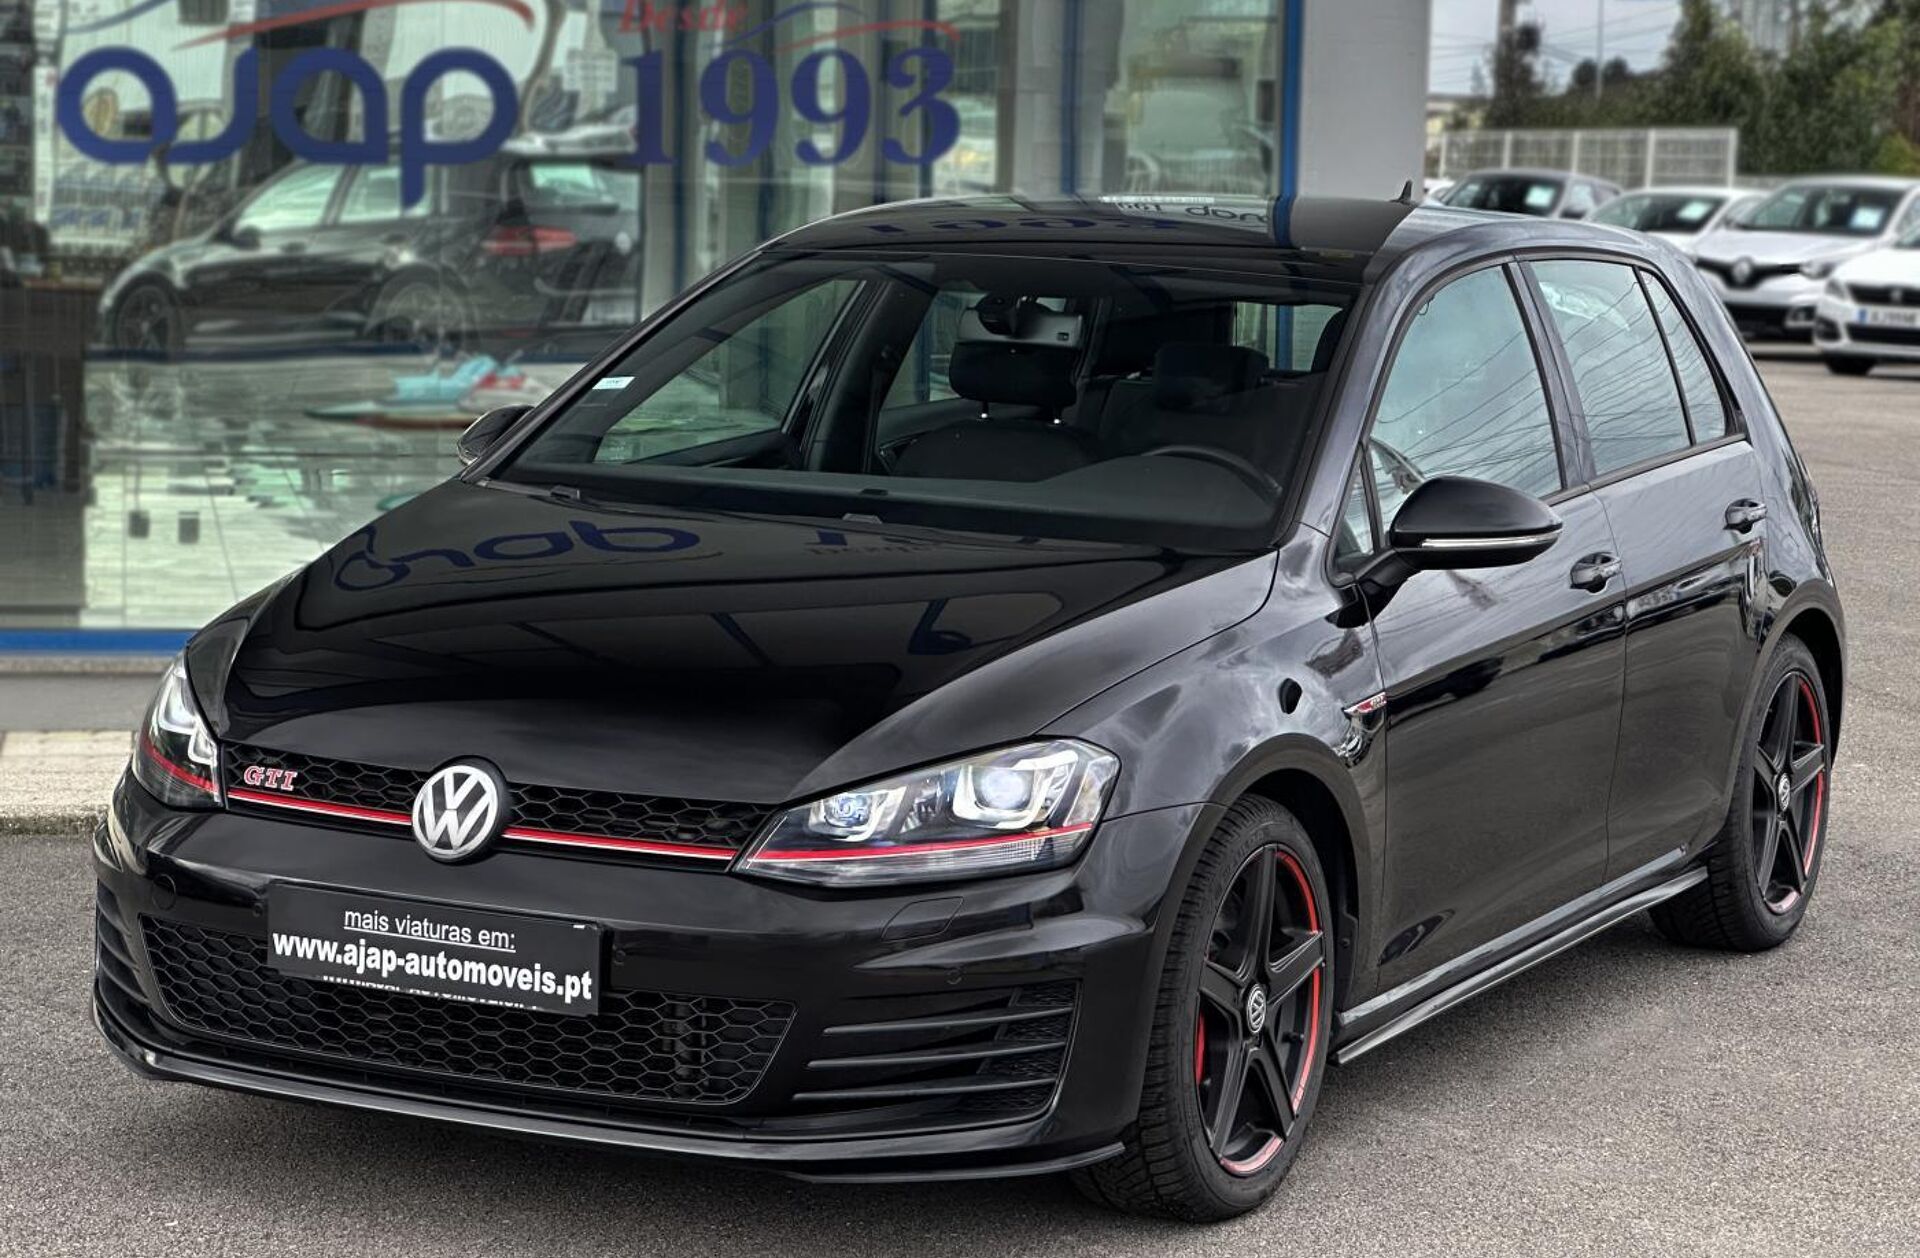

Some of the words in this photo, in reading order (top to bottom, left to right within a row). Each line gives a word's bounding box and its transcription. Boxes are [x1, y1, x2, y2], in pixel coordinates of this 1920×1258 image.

[617, 0, 748, 32] Desde
[620, 48, 961, 167] 1993
[243, 765, 298, 792] GTI
[413, 764, 499, 859] VW
[344, 910, 390, 935] mais
[394, 914, 473, 945] viaturas
[477, 929, 516, 952] em:
[272, 932, 593, 1003] www.ajap-automoveis.pt
